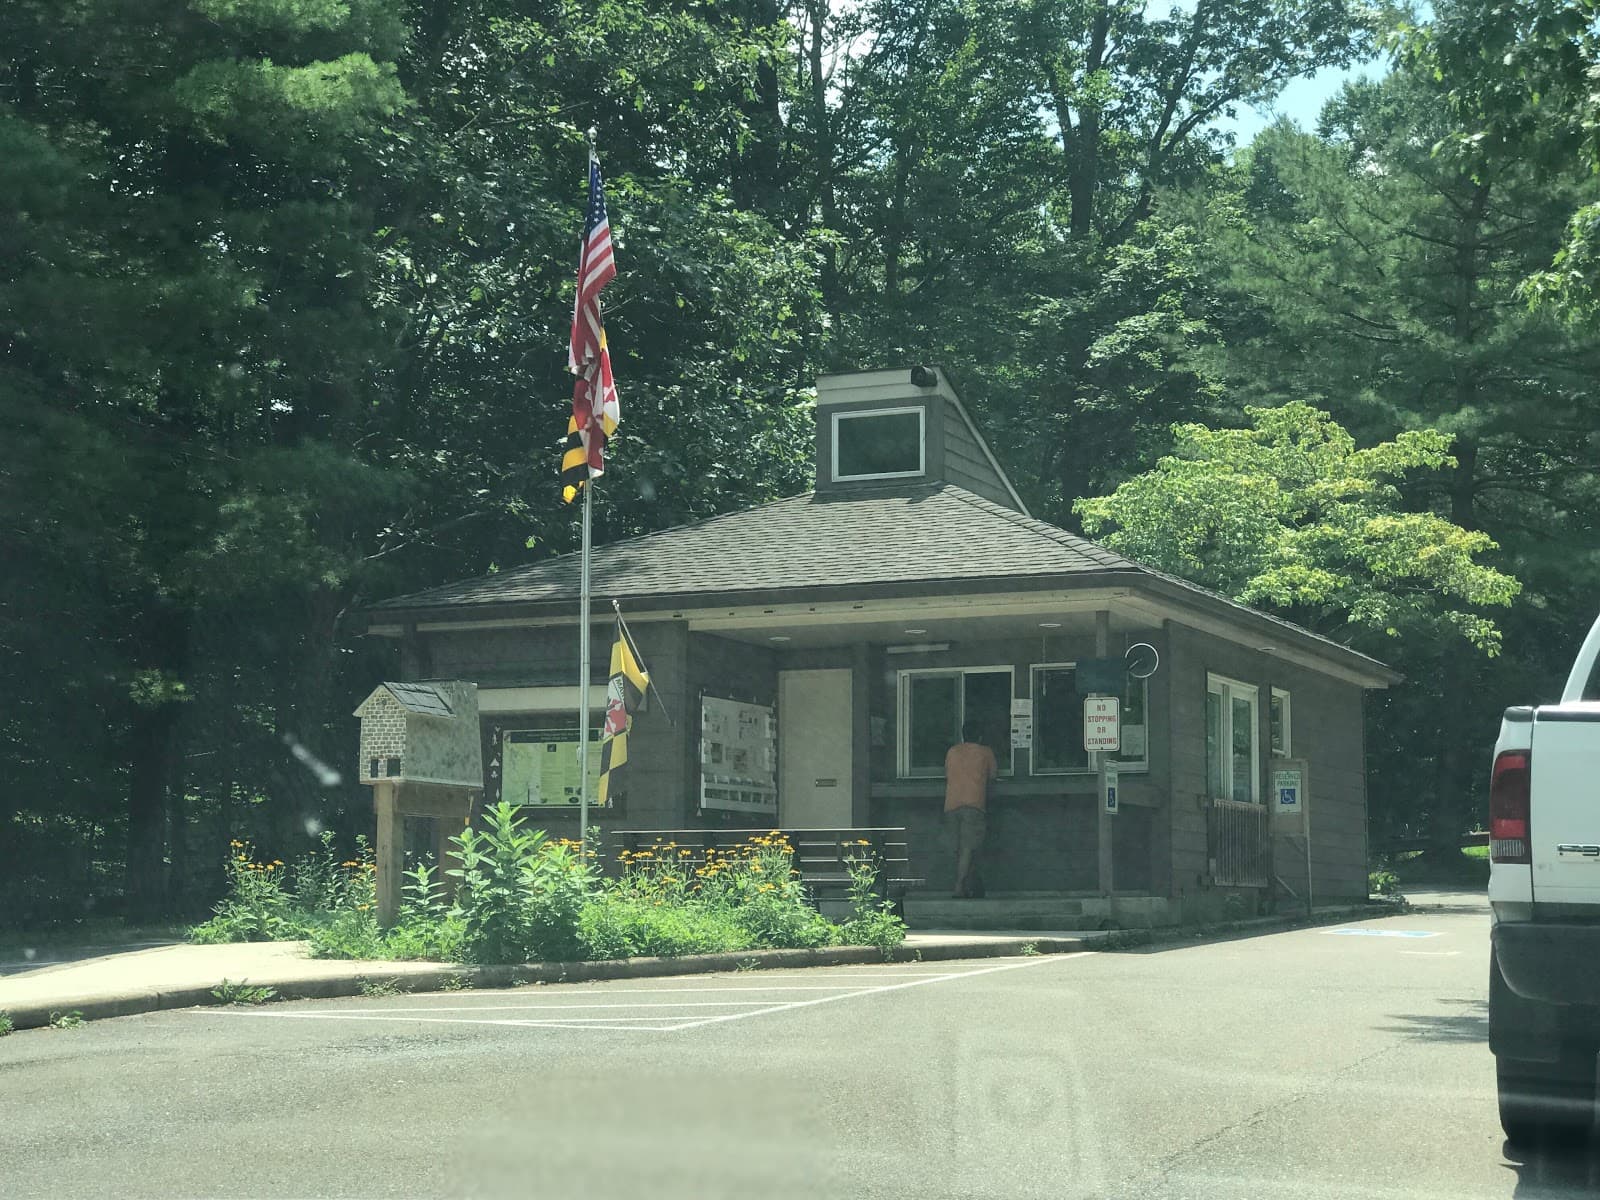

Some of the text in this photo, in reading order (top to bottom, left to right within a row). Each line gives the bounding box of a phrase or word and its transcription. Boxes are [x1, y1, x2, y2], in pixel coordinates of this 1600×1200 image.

[1096, 704, 1106, 712] NO
[1087, 715, 1117, 723] STOPPING
[1096, 726, 1106, 734] OR
[1087, 737, 1117, 745] STANDING
[1557, 843, 1600, 857] F3
